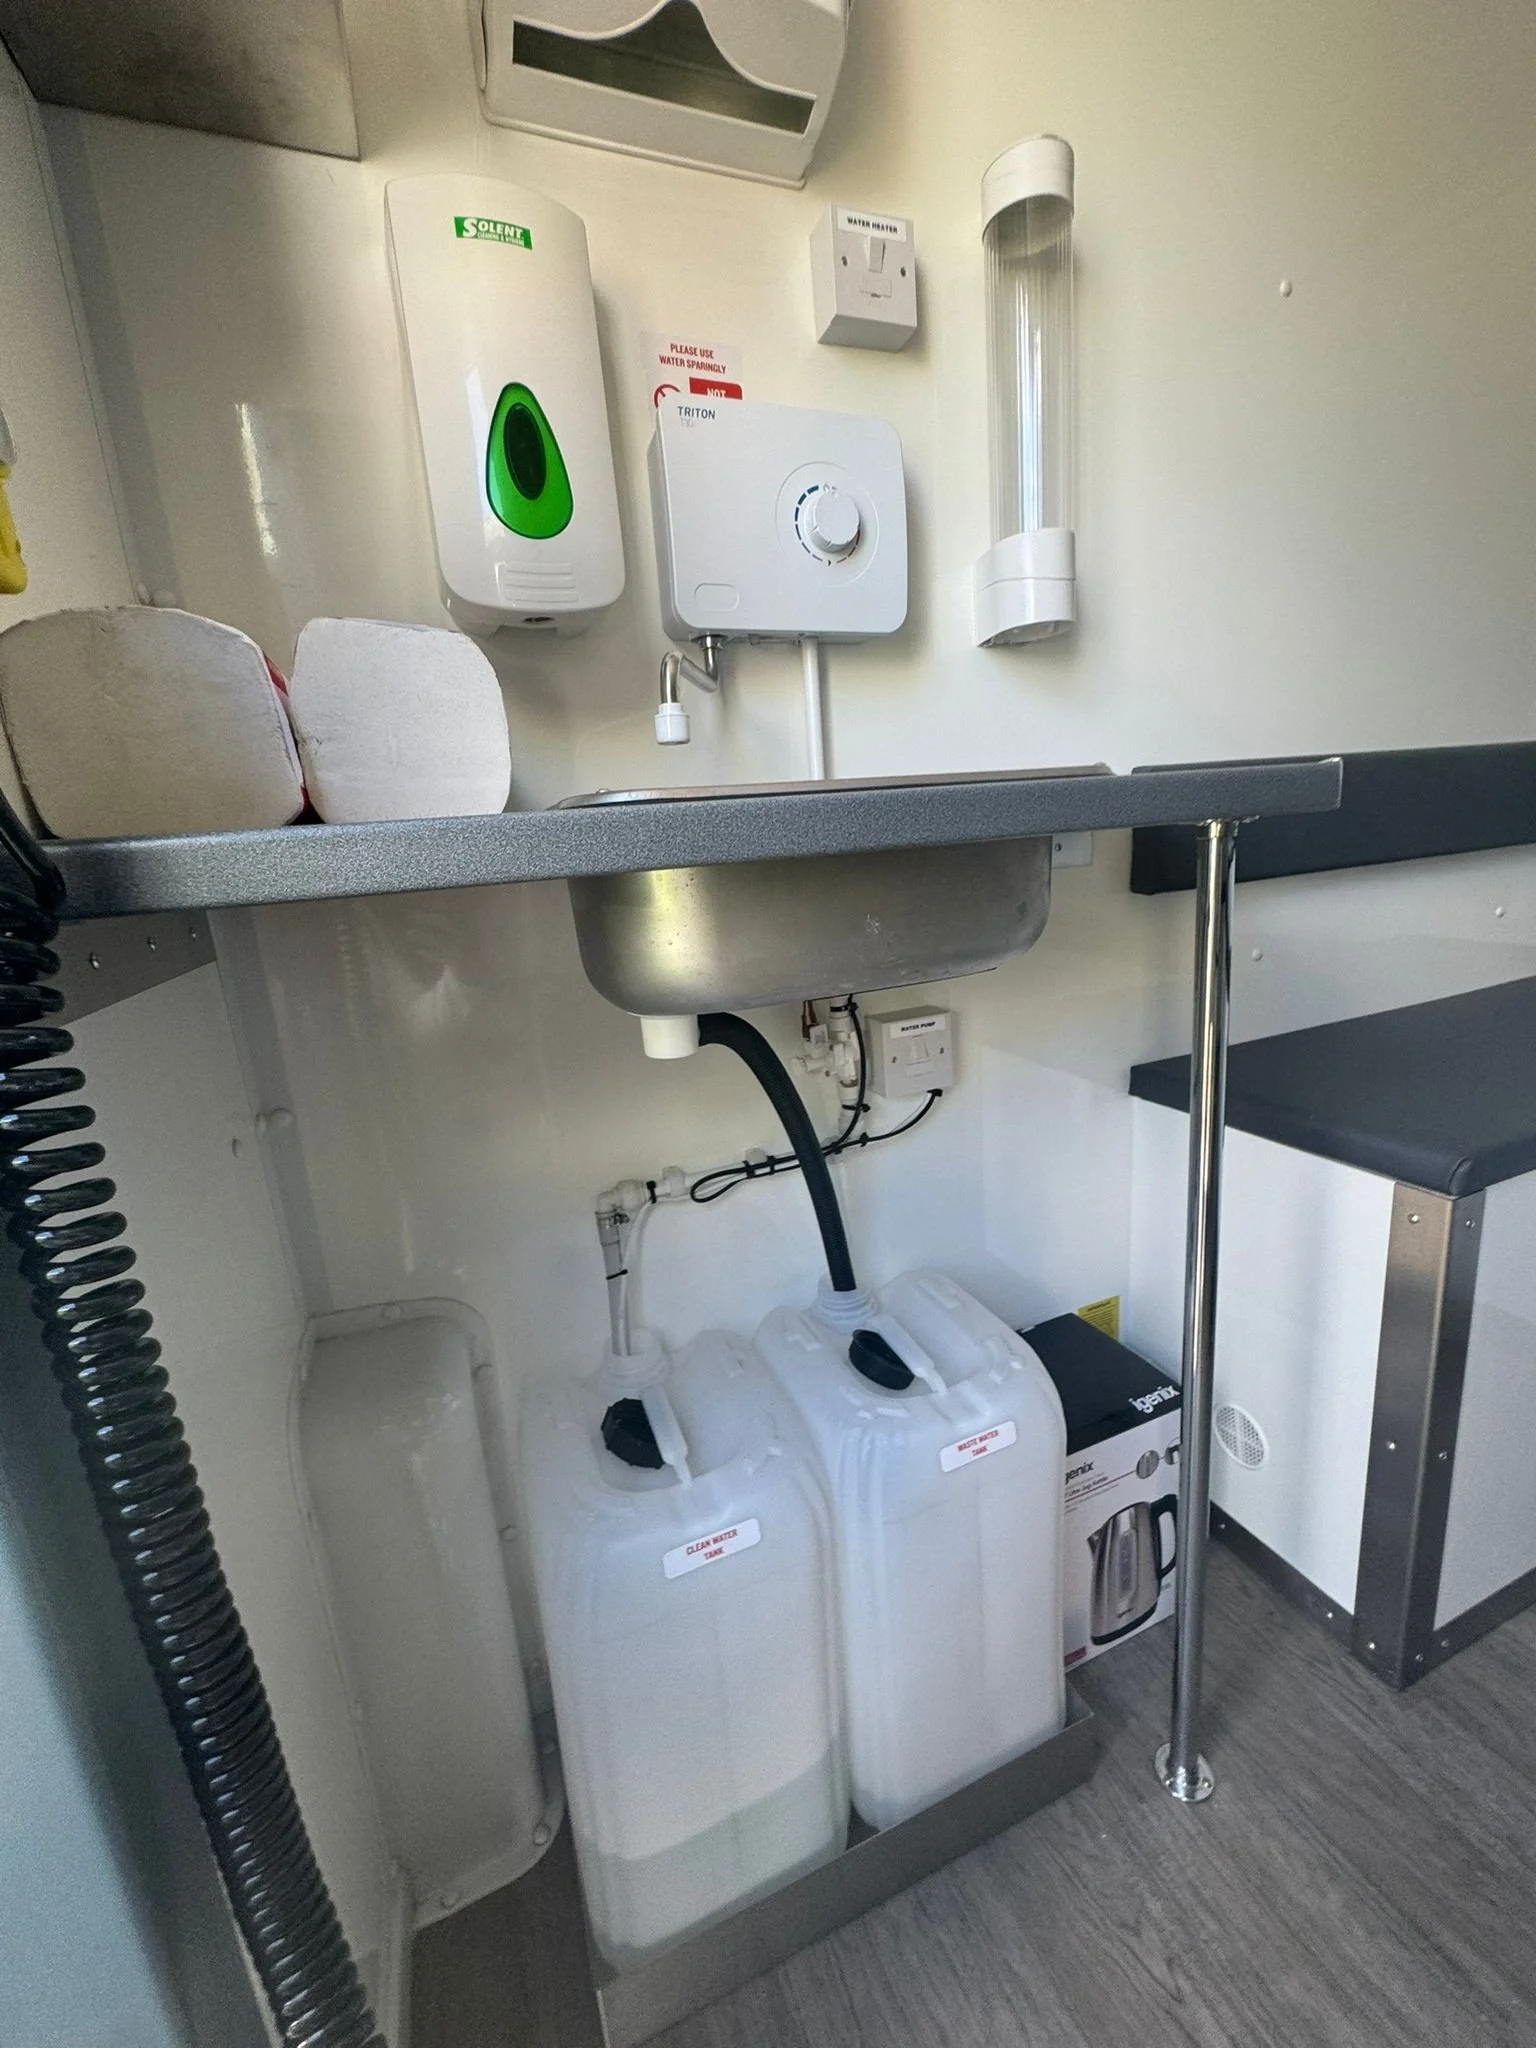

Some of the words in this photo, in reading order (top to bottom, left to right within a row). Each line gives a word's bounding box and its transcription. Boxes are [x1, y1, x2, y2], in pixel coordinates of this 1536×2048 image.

[463, 218, 523, 239] SOLENT
[847, 216, 870, 228] WATER
[872, 223, 898, 234] HEATER
[670, 343, 698, 357] PLEASE
[700, 349, 714, 359] USE
[659, 355, 685, 367] WATER
[686, 359, 726, 374] SPARINGLY
[677, 406, 716, 419] TRITON
[901, 1024, 919, 1032] WATER
[920, 1021, 936, 1029] PUMP
[1128, 1385, 1180, 1413] igenix
[979, 1429, 999, 1443] WATER
[971, 1445, 988, 1456] TANK
[686, 1539, 711, 1555] CLEAN
[712, 1529, 738, 1544] WATER
[703, 1546, 724, 1560] TANK
